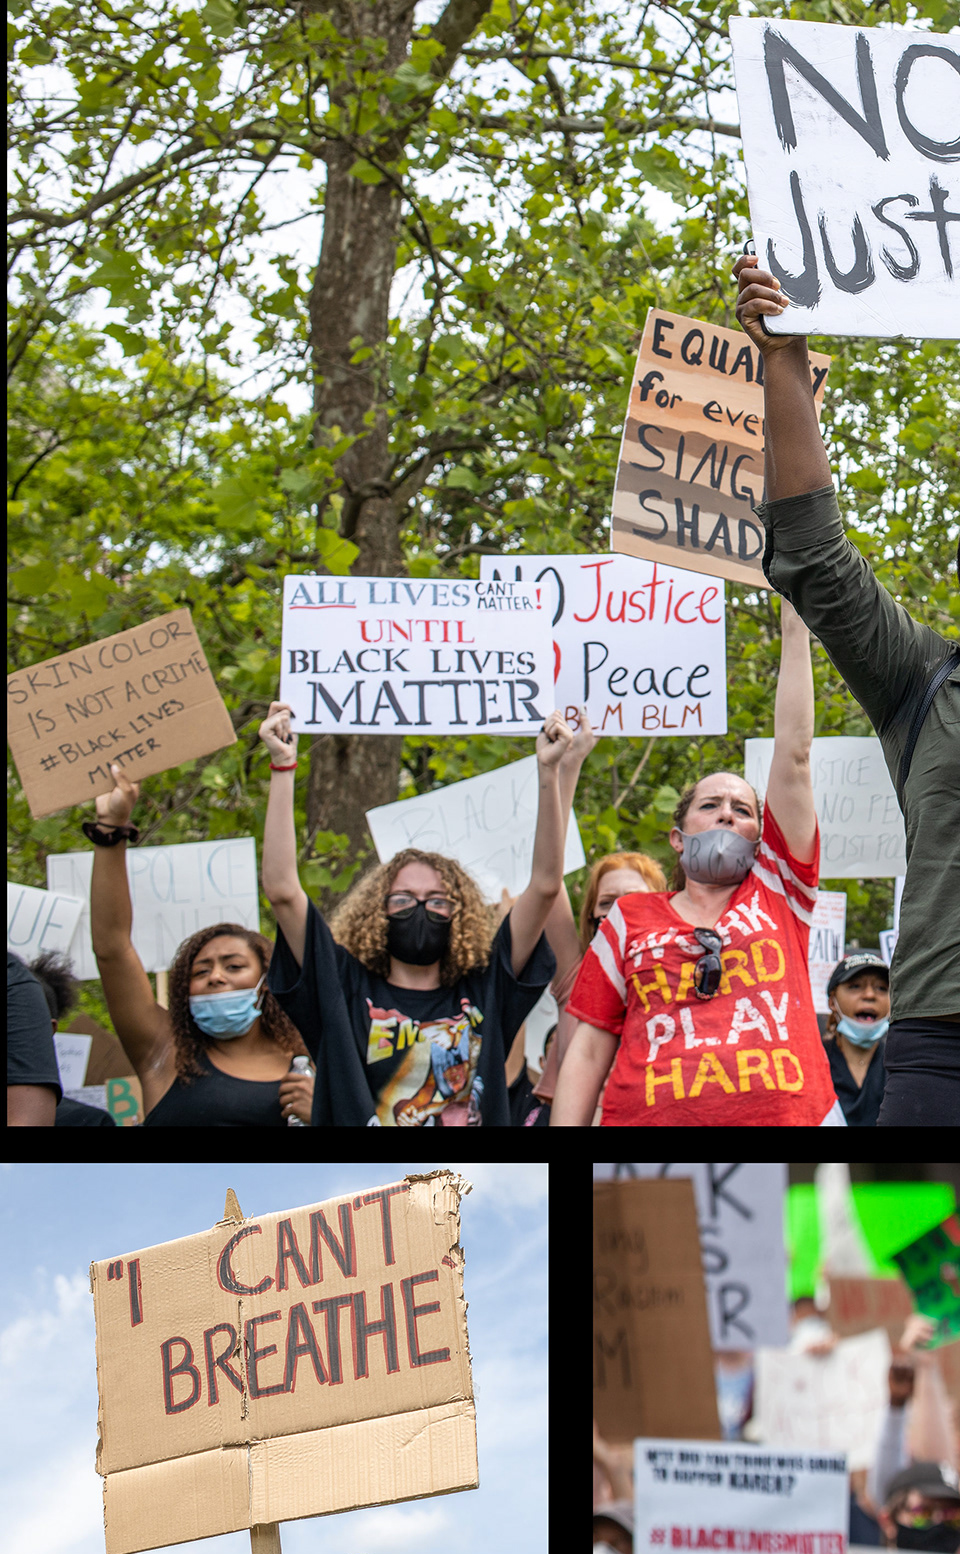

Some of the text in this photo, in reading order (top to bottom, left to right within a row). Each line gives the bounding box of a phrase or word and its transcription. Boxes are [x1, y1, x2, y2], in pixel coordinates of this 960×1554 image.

[638, 371, 764, 436] for eve
[629, 424, 766, 511] SING
[289, 581, 471, 607] ALL LIVES
[573, 560, 721, 624] Justice
[359, 619, 475, 643] UNTIL
[8, 621, 192, 704] SKIN COLOR
[288, 649, 410, 674] BLACK
[431, 650, 536, 675] LIVES
[583, 641, 711, 703] Peace
[28, 709, 57, 740] IS
[65, 685, 115, 724] NOT
[305, 678, 546, 726] MATTER
[641, 702, 703, 731] BLM
[39, 699, 185, 772] #BLACK LIVES
[813, 755, 871, 789] STICE
[821, 793, 900, 825] NO PE
[645, 990, 789, 1063] PLAY
[645, 1047, 804, 1107] HARD
[216, 1183, 409, 1296] CAN'T
